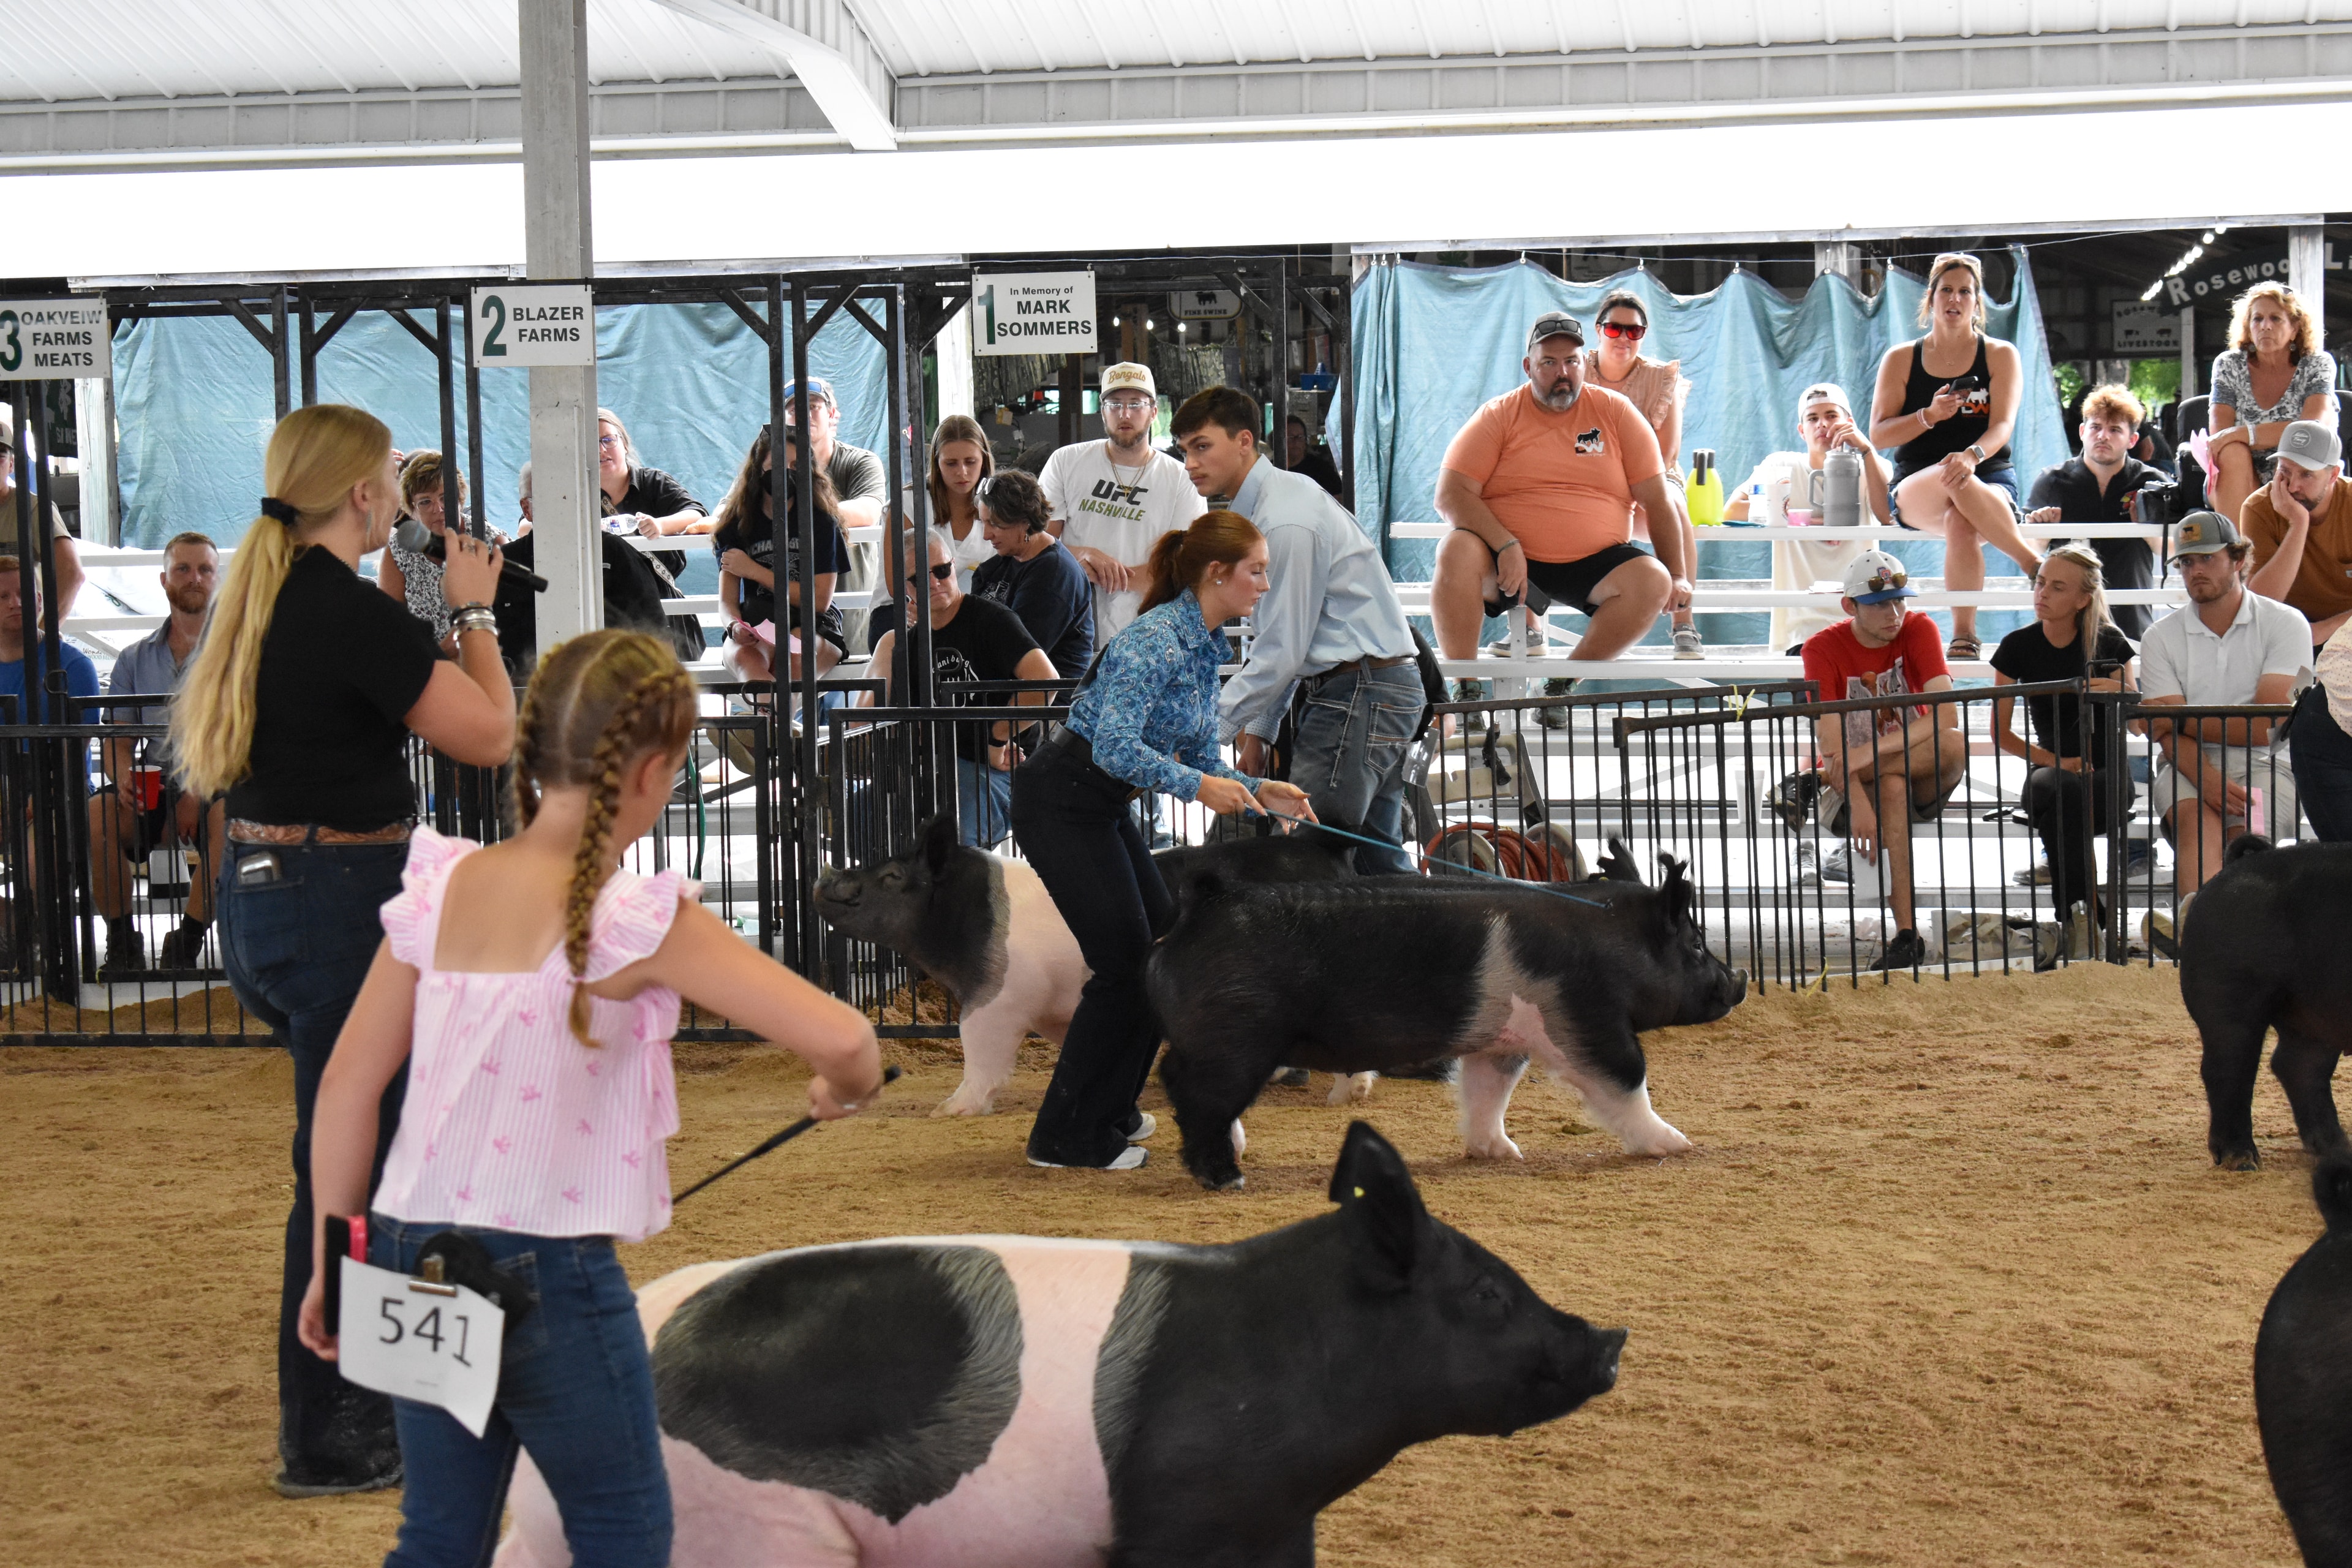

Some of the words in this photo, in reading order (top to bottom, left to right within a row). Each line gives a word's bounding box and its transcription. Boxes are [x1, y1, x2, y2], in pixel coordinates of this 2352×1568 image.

[2166, 258, 2290, 306] Rosewoo
[1022, 287, 1061, 296] Memory
[513, 306, 584, 321] BLAZER
[978, 285, 996, 345] 1
[1017, 300, 1071, 314] MARK
[21, 310, 102, 326] OAKVEIW
[481, 295, 507, 356] 2
[518, 328, 580, 342] FARMS
[997, 320, 1091, 337] SOMMERS
[0, 309, 23, 372] 3
[32, 331, 93, 346] FARMS
[34, 352, 94, 367] MEATS
[1108, 370, 1146, 384] Bengals
[1575, 442, 1604, 453] DW
[1091, 479, 1149, 506] UFC
[1078, 499, 1146, 521] NASHVILLE
[380, 1297, 472, 1367] 541
